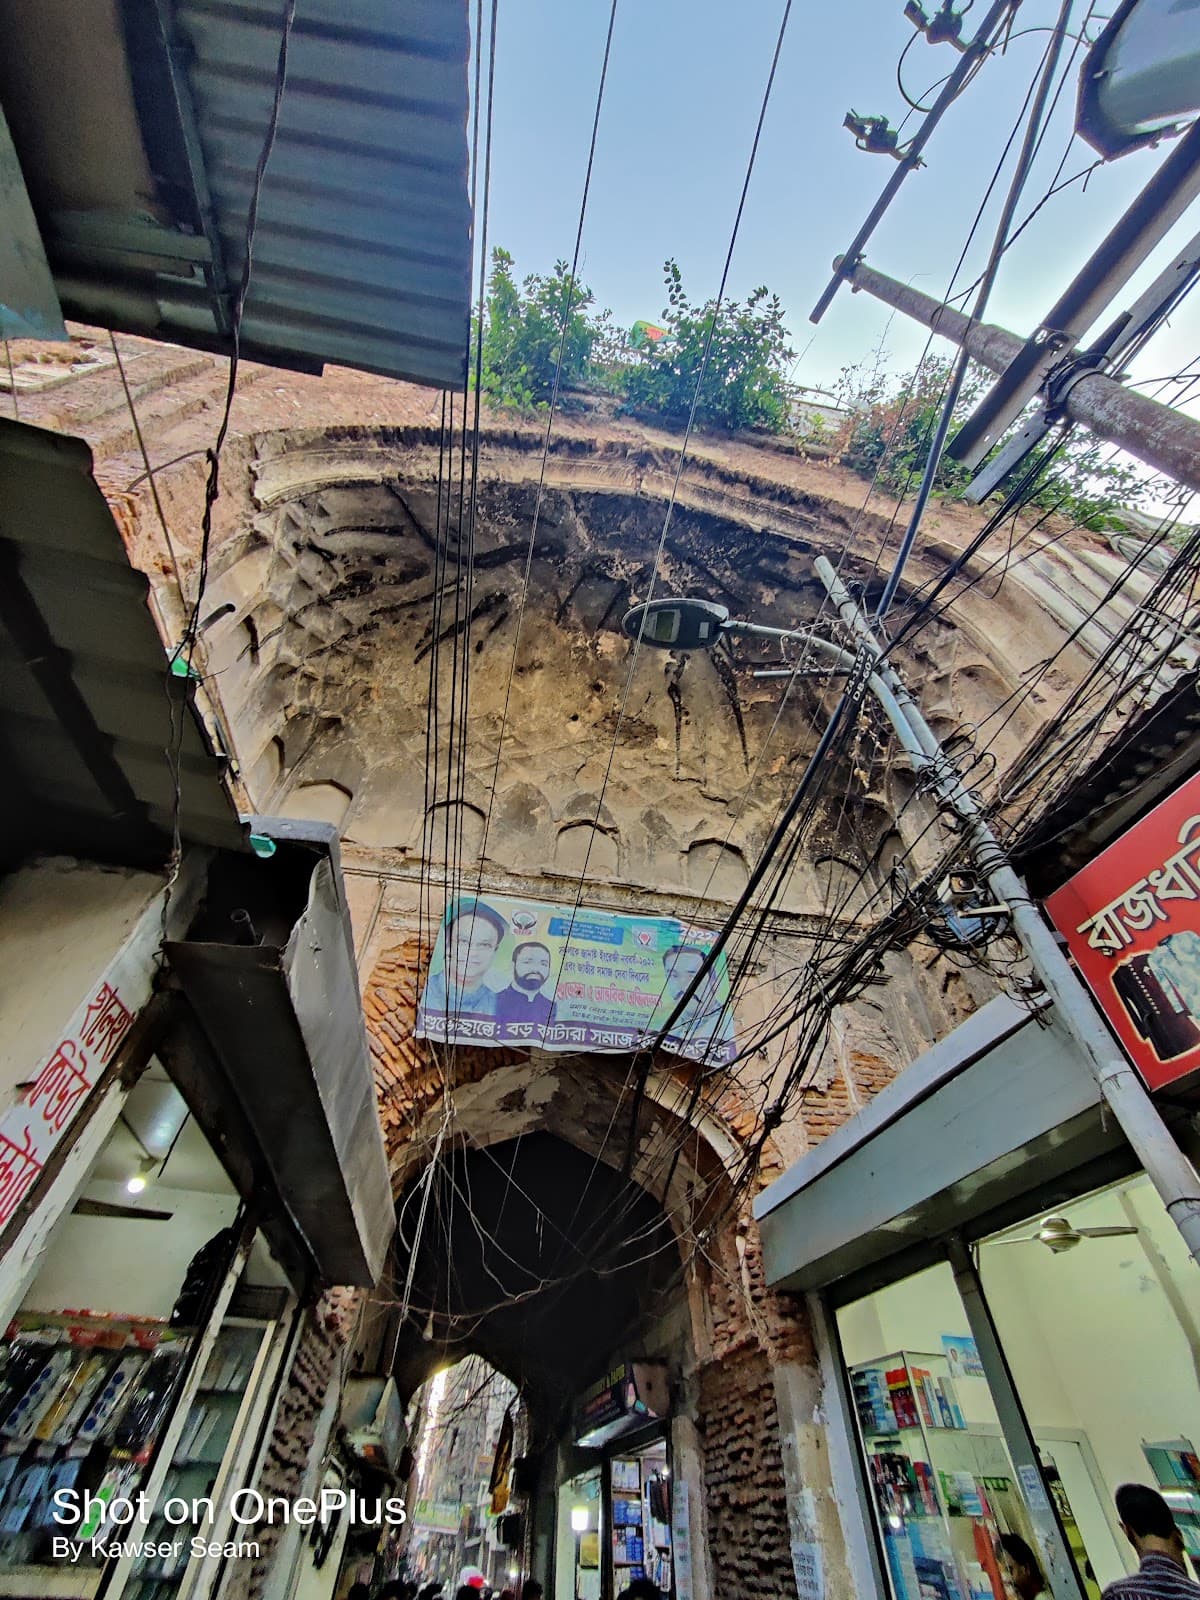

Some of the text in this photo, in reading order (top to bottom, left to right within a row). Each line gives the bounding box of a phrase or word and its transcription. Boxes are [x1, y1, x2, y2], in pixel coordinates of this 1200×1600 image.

[852, 653, 873, 701] DB-607
[506, 1022, 534, 1036] বড়
[537, 1023, 587, 1042] কাটারা
[589, 1028, 633, 1046] সমাজ
